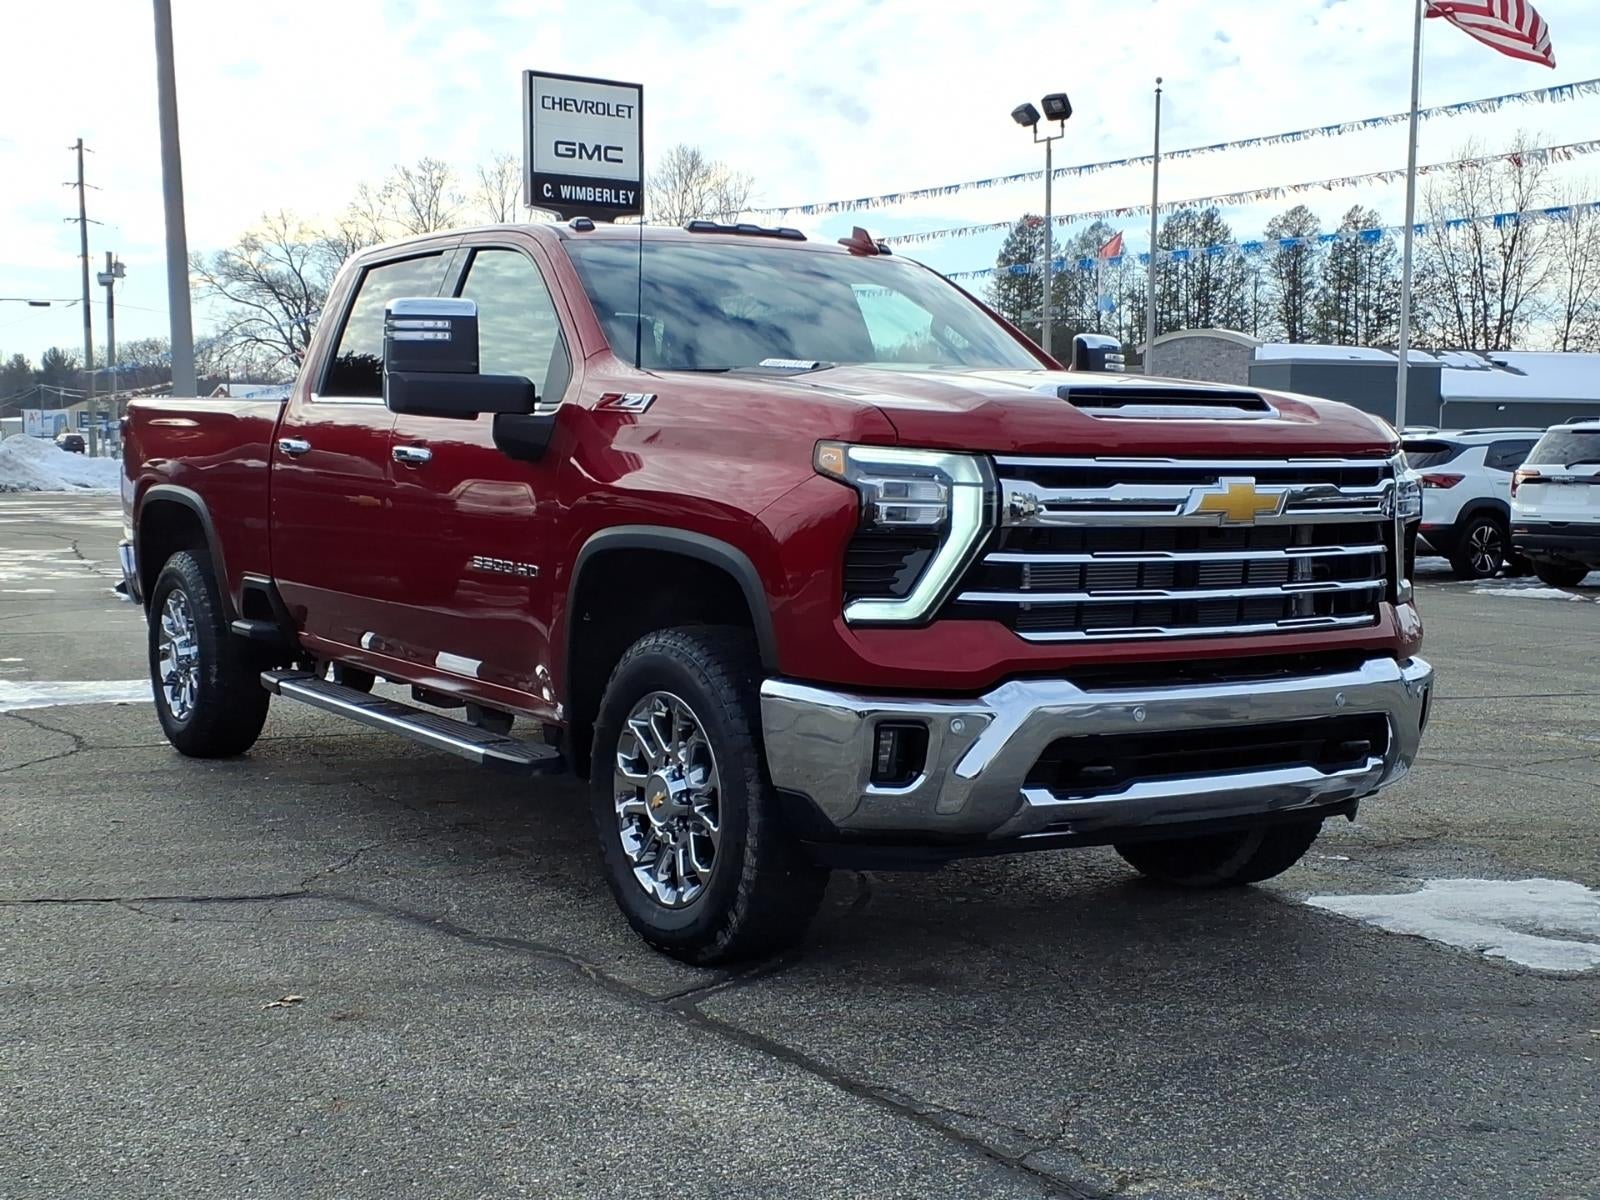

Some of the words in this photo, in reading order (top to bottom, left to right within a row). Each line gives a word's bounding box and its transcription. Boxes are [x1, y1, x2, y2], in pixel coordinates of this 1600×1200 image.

[541, 95, 634, 119] CHEVROLET
[553, 140, 624, 164] GMC
[542, 183, 554, 198] C.
[560, 184, 635, 205] WIMBERLEY
[594, 392, 655, 412] Z71
